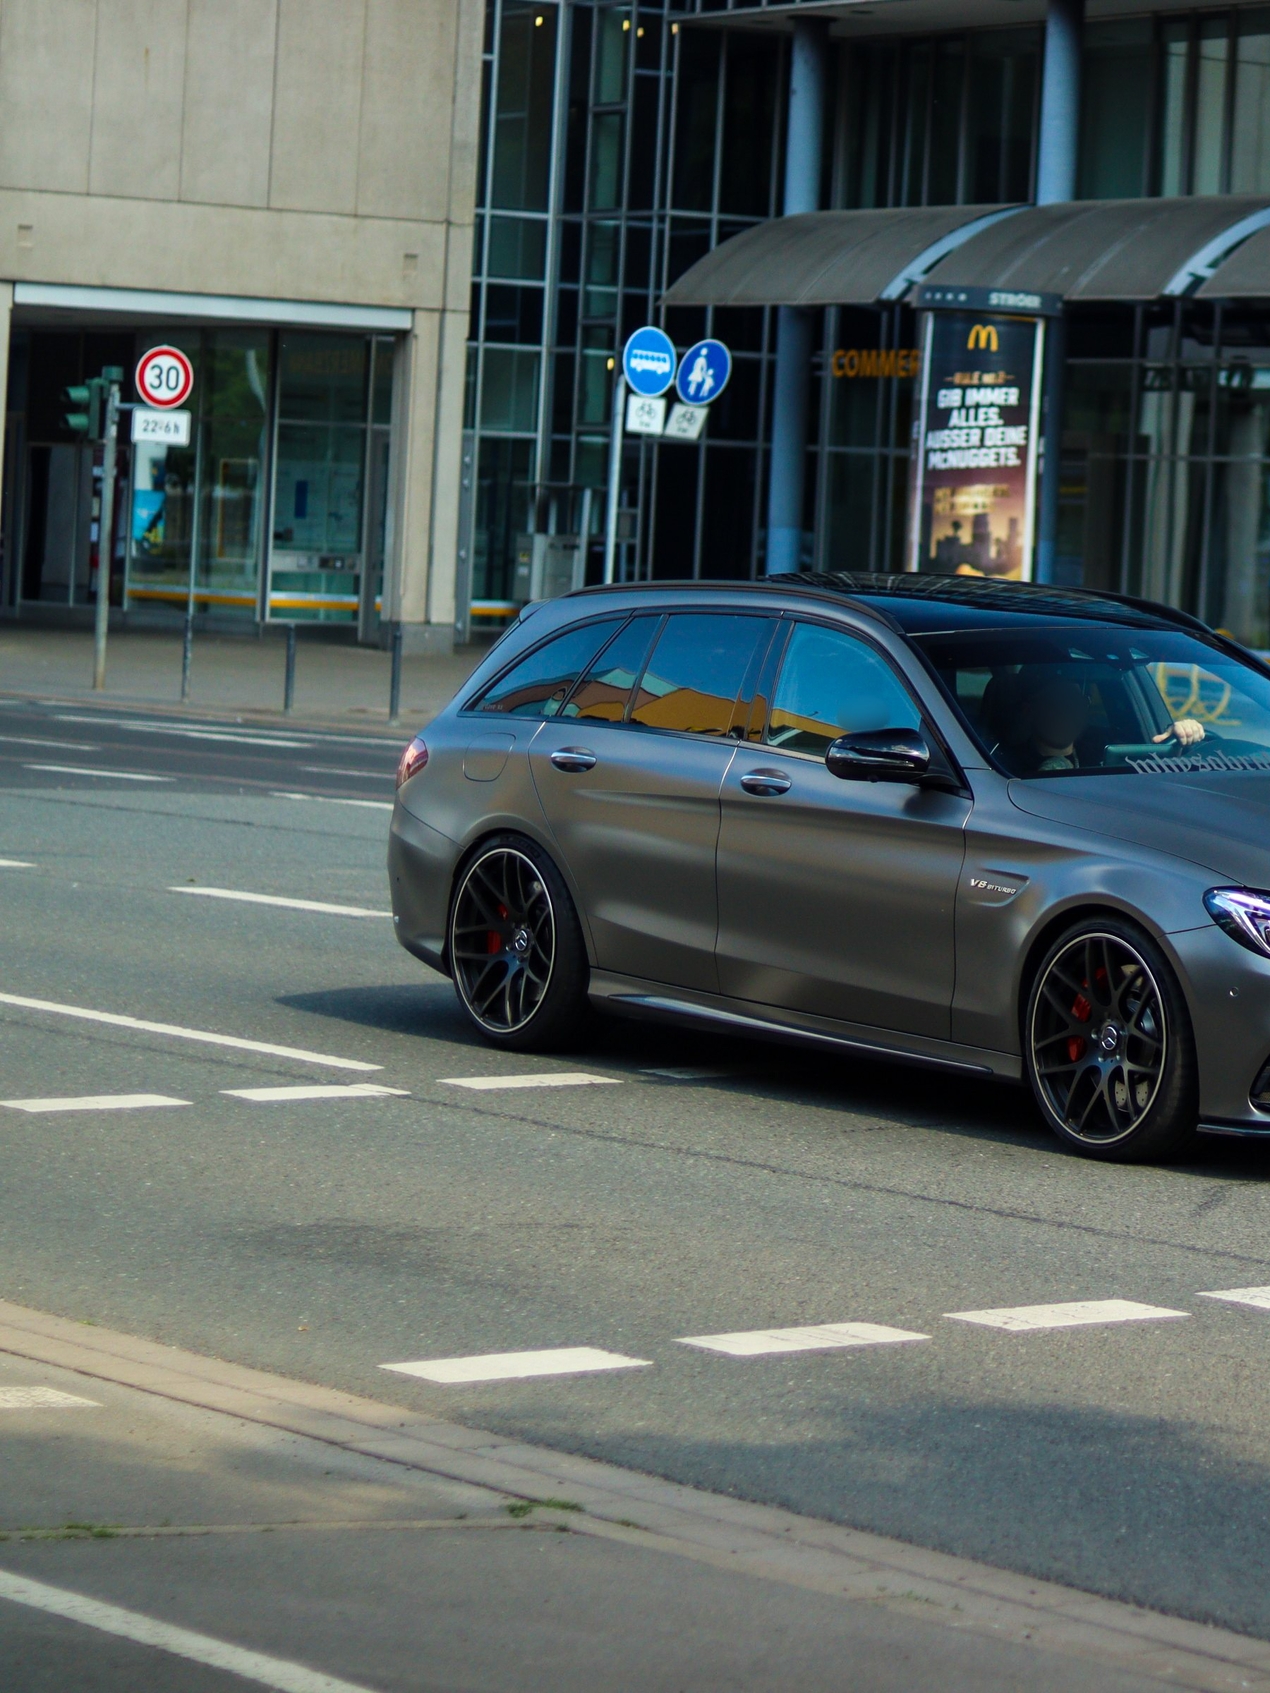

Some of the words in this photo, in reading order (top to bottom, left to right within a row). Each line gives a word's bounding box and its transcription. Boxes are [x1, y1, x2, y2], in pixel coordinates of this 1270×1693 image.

[149, 364, 180, 391] 30
[965, 387, 1019, 407] IMMER
[948, 406, 1005, 428] ALLES.
[984, 425, 1028, 447] DEINE
[970, 878, 988, 889] V8
[987, 884, 1017, 894] BITURBO
